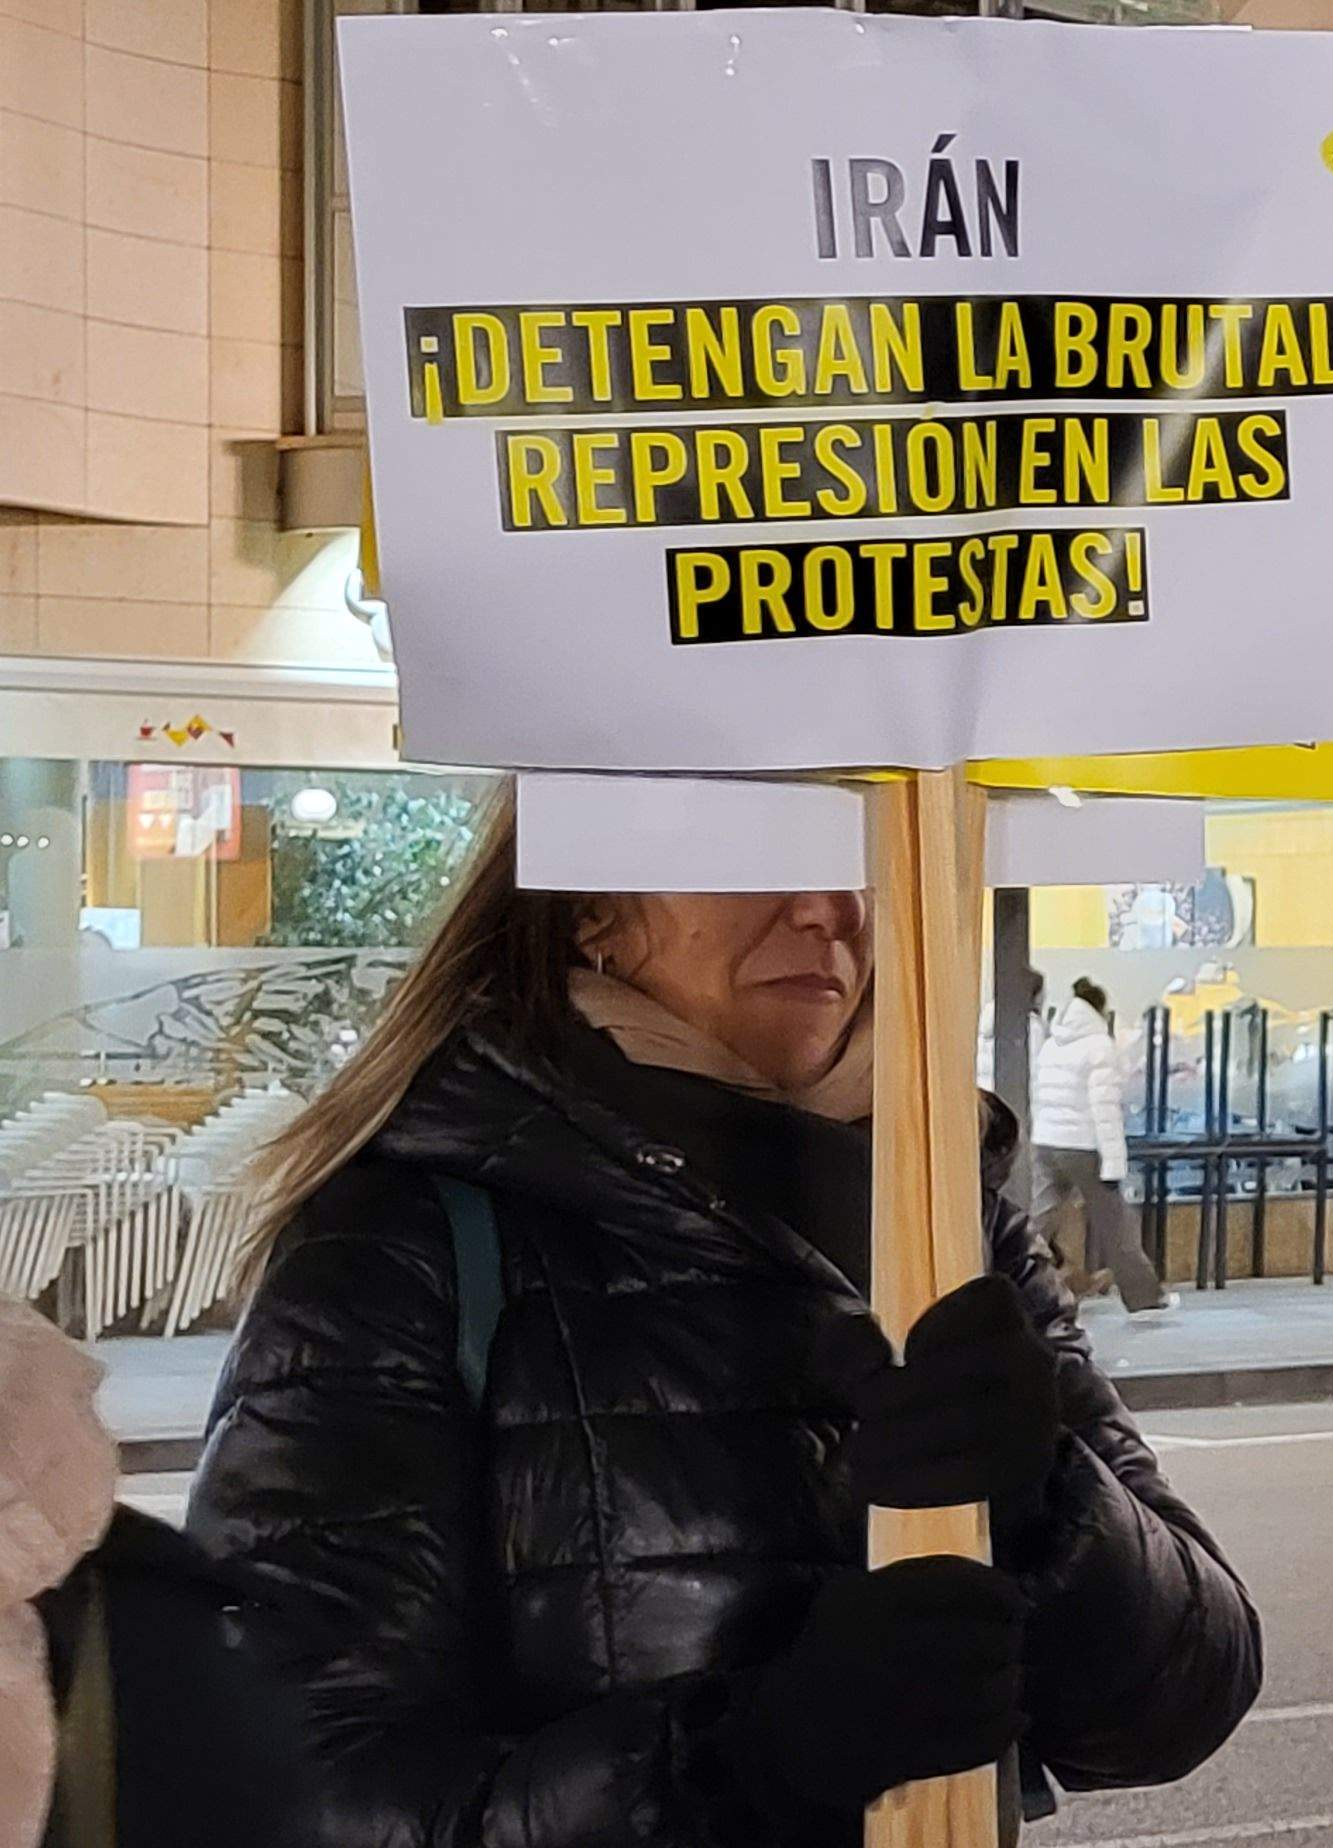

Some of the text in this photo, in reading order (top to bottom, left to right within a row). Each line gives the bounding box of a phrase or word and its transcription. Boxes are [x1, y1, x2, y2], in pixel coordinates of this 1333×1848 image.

[811, 133, 1021, 260] IRÁN
[419, 301, 921, 424] ¡DETENGAN
[956, 301, 1033, 391] LA
[507, 405, 1286, 528] REPRESIÓN EN LAS
[675, 530, 1144, 638] PROTESTAS!
